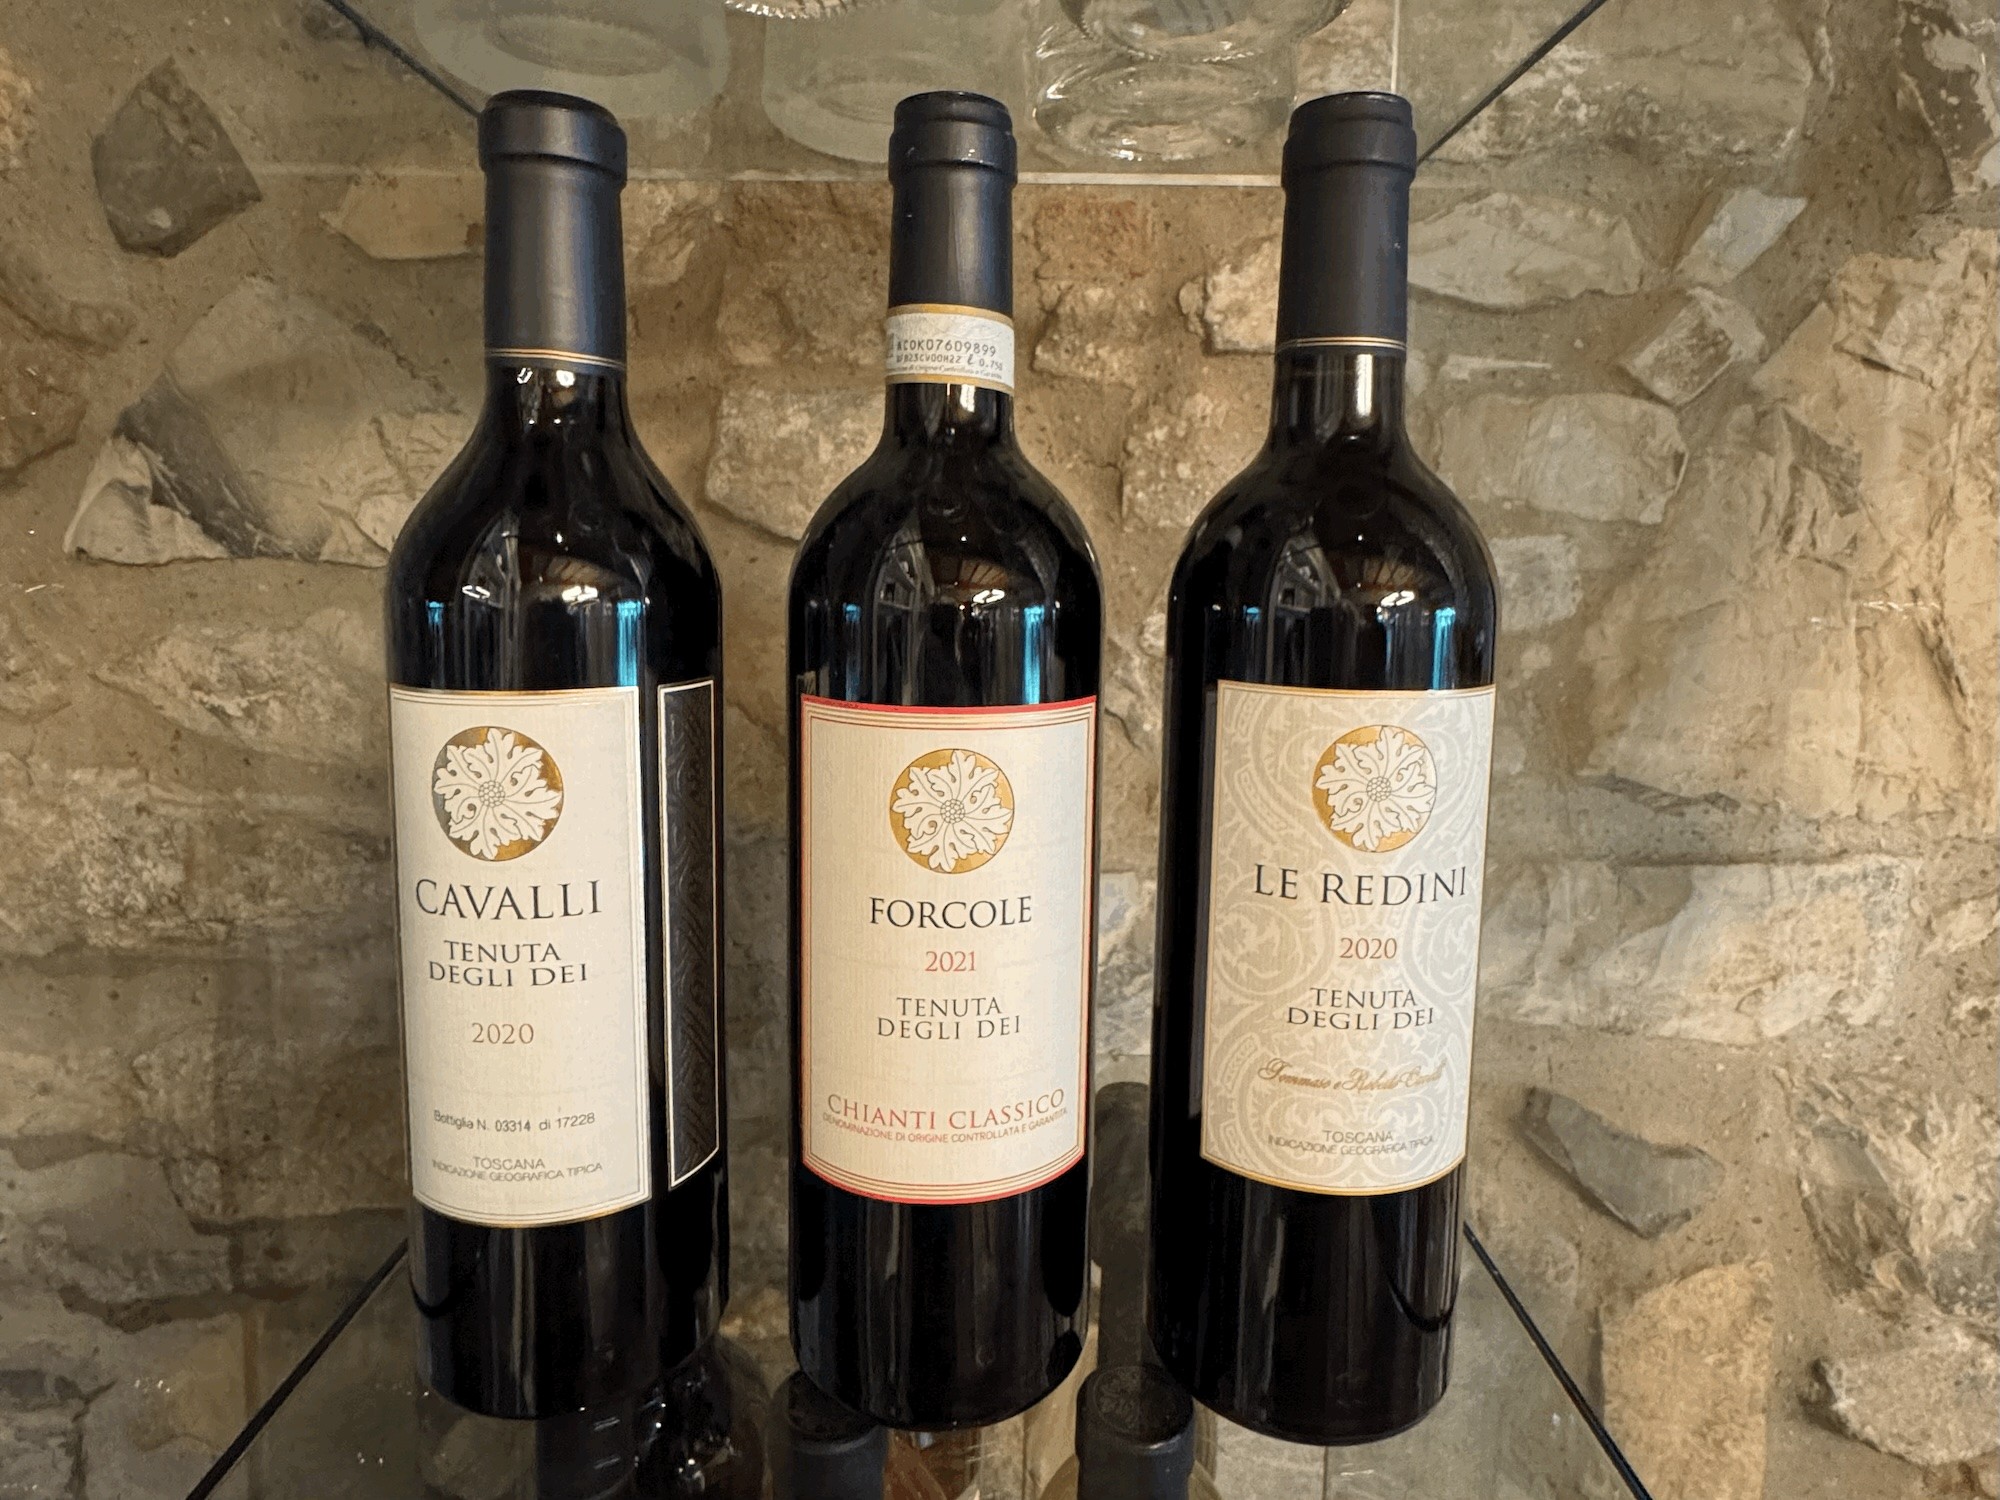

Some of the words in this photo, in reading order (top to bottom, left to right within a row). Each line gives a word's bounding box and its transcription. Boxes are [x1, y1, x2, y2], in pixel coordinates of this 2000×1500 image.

[1254, 863, 1298, 900] LE
[1320, 866, 1466, 906] REDINI
[416, 879, 602, 920] CAVALLI
[869, 895, 1032, 929] FORCOLE
[443, 940, 562, 963] TENUTA
[1339, 937, 1398, 959] 2020
[925, 950, 976, 973] 2021
[429, 961, 514, 987] DEGLI
[530, 963, 588, 986] DEI
[897, 997, 1002, 1017] TENUTA
[1309, 987, 1418, 1009] TENUTA
[877, 1016, 961, 1040] DEGLI
[977, 1015, 1021, 1039] DEI
[1286, 1007, 1380, 1031] DEGLI
[1393, 1007, 1434, 1030] DEI
[471, 1022, 534, 1045] 2020
[828, 1094, 936, 1130] CHIANTI
[949, 1088, 1065, 1130] CLASSICO
[434, 1110, 474, 1131] Bottiglia
[495, 1119, 531, 1132] 03314
[539, 1119, 550, 1130] di
[557, 1112, 596, 1129] 17228
[822, 1111, 893, 1141] DENOMINAZIONE
[896, 1132, 905, 1142] DI
[908, 1133, 948, 1143] ORIGINE
[951, 1125, 1020, 1143] CONTROLLATA
[1021, 1124, 1028, 1133] E
[1267, 1134, 1338, 1155] INDICAZIONE
[1341, 1142, 1407, 1156] GEOGRAFICA
[1322, 1129, 1394, 1145] TOSCANA
[473, 1156, 546, 1171] TOSCANA
[489, 1170, 564, 1182] GEOGRAFICA
[567, 1162, 603, 1176] TIPICA
